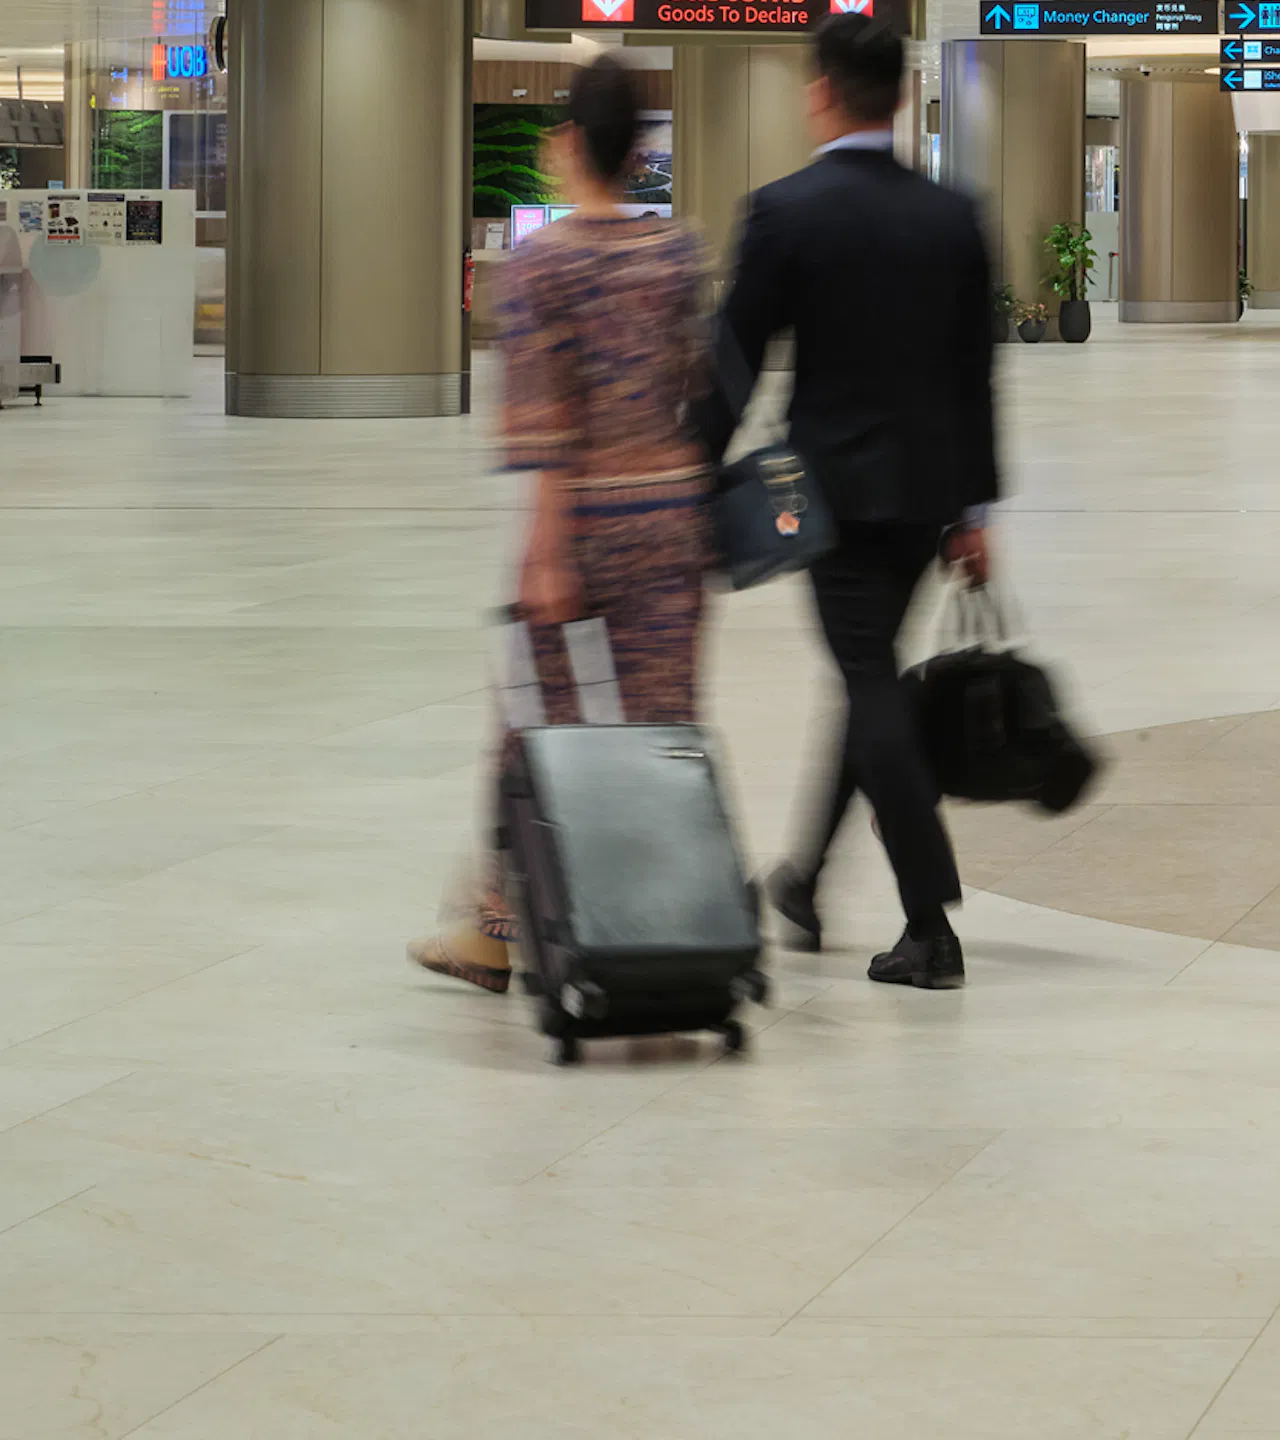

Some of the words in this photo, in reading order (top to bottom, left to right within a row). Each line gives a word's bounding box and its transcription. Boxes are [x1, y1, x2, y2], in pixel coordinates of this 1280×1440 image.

[657, 4, 715, 23] Goods
[718, 6, 741, 23] To
[745, 7, 809, 25] Declare
[1043, 10, 1090, 26] Money
[1092, 10, 1151, 27] Changer
[167, 45, 207, 78] UOB
